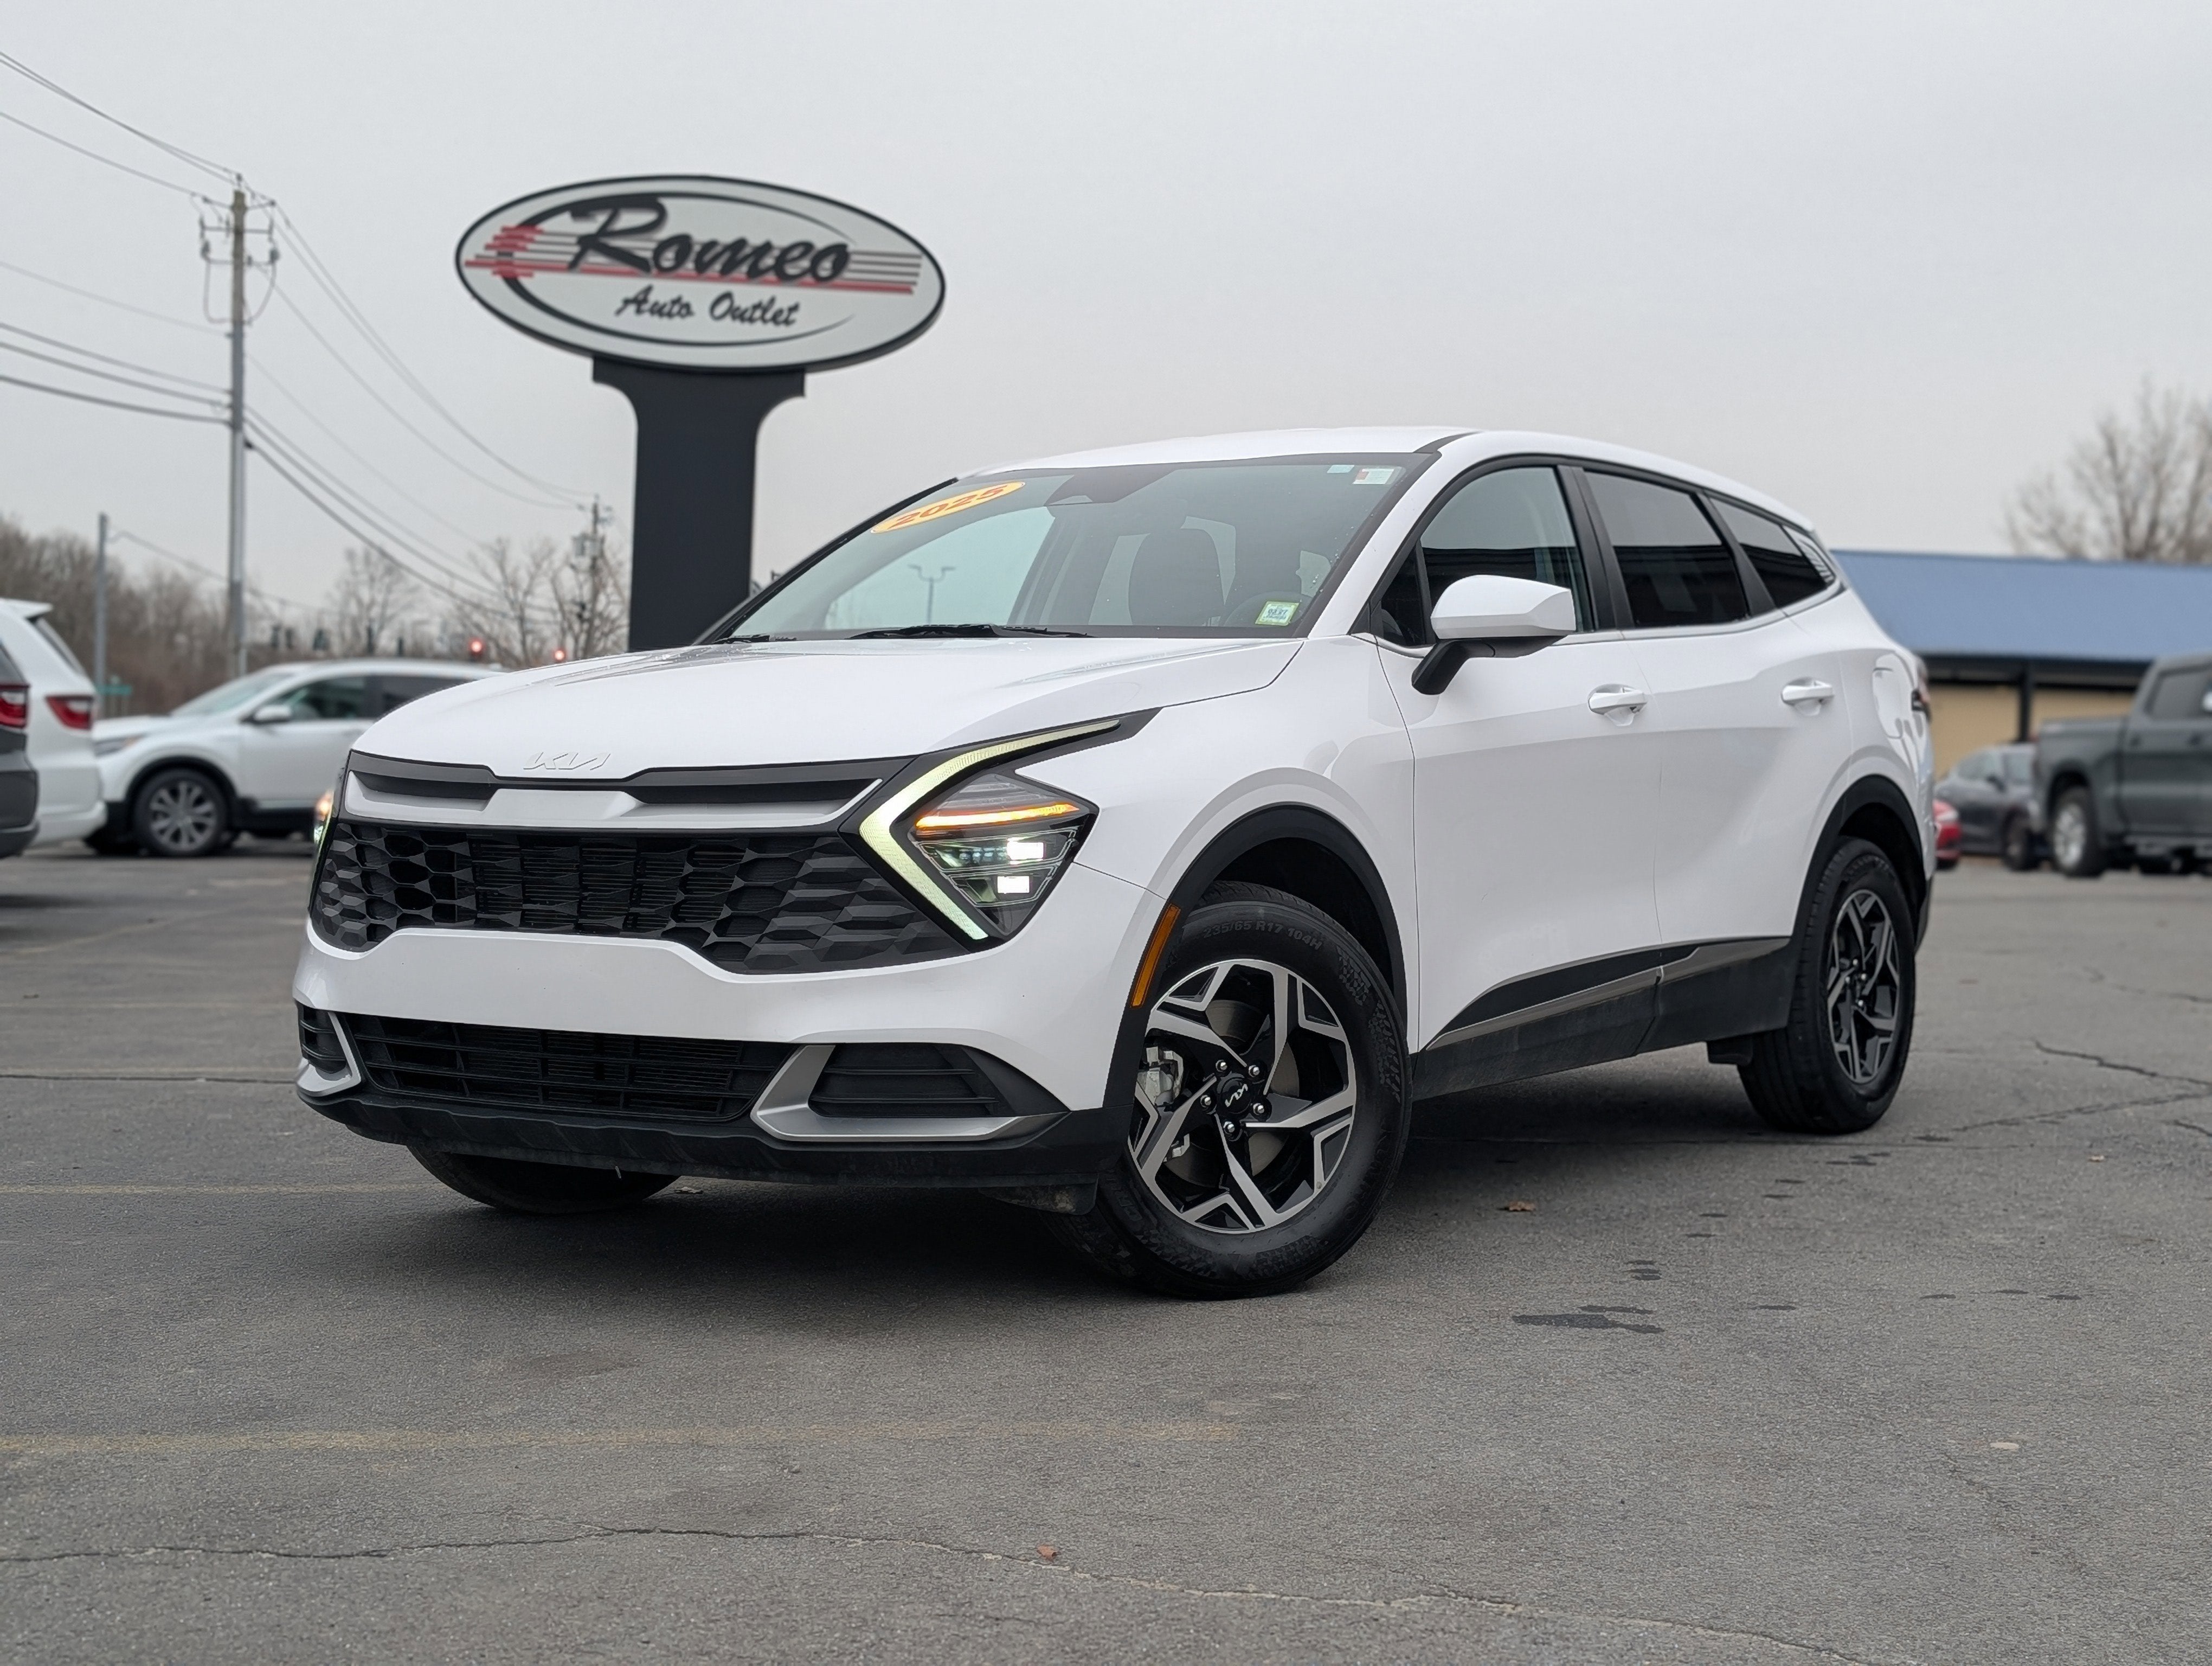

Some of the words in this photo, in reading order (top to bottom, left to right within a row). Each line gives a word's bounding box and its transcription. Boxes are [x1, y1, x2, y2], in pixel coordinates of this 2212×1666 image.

[567, 196, 852, 284] Romeo
[614, 285, 694, 318] Auto
[709, 291, 800, 326] Outlet
[886, 484, 1008, 530] 2025
[1203, 920, 1252, 939] 235/65
[1255, 920, 1284, 933] R17
[1287, 927, 1323, 951] 104H
